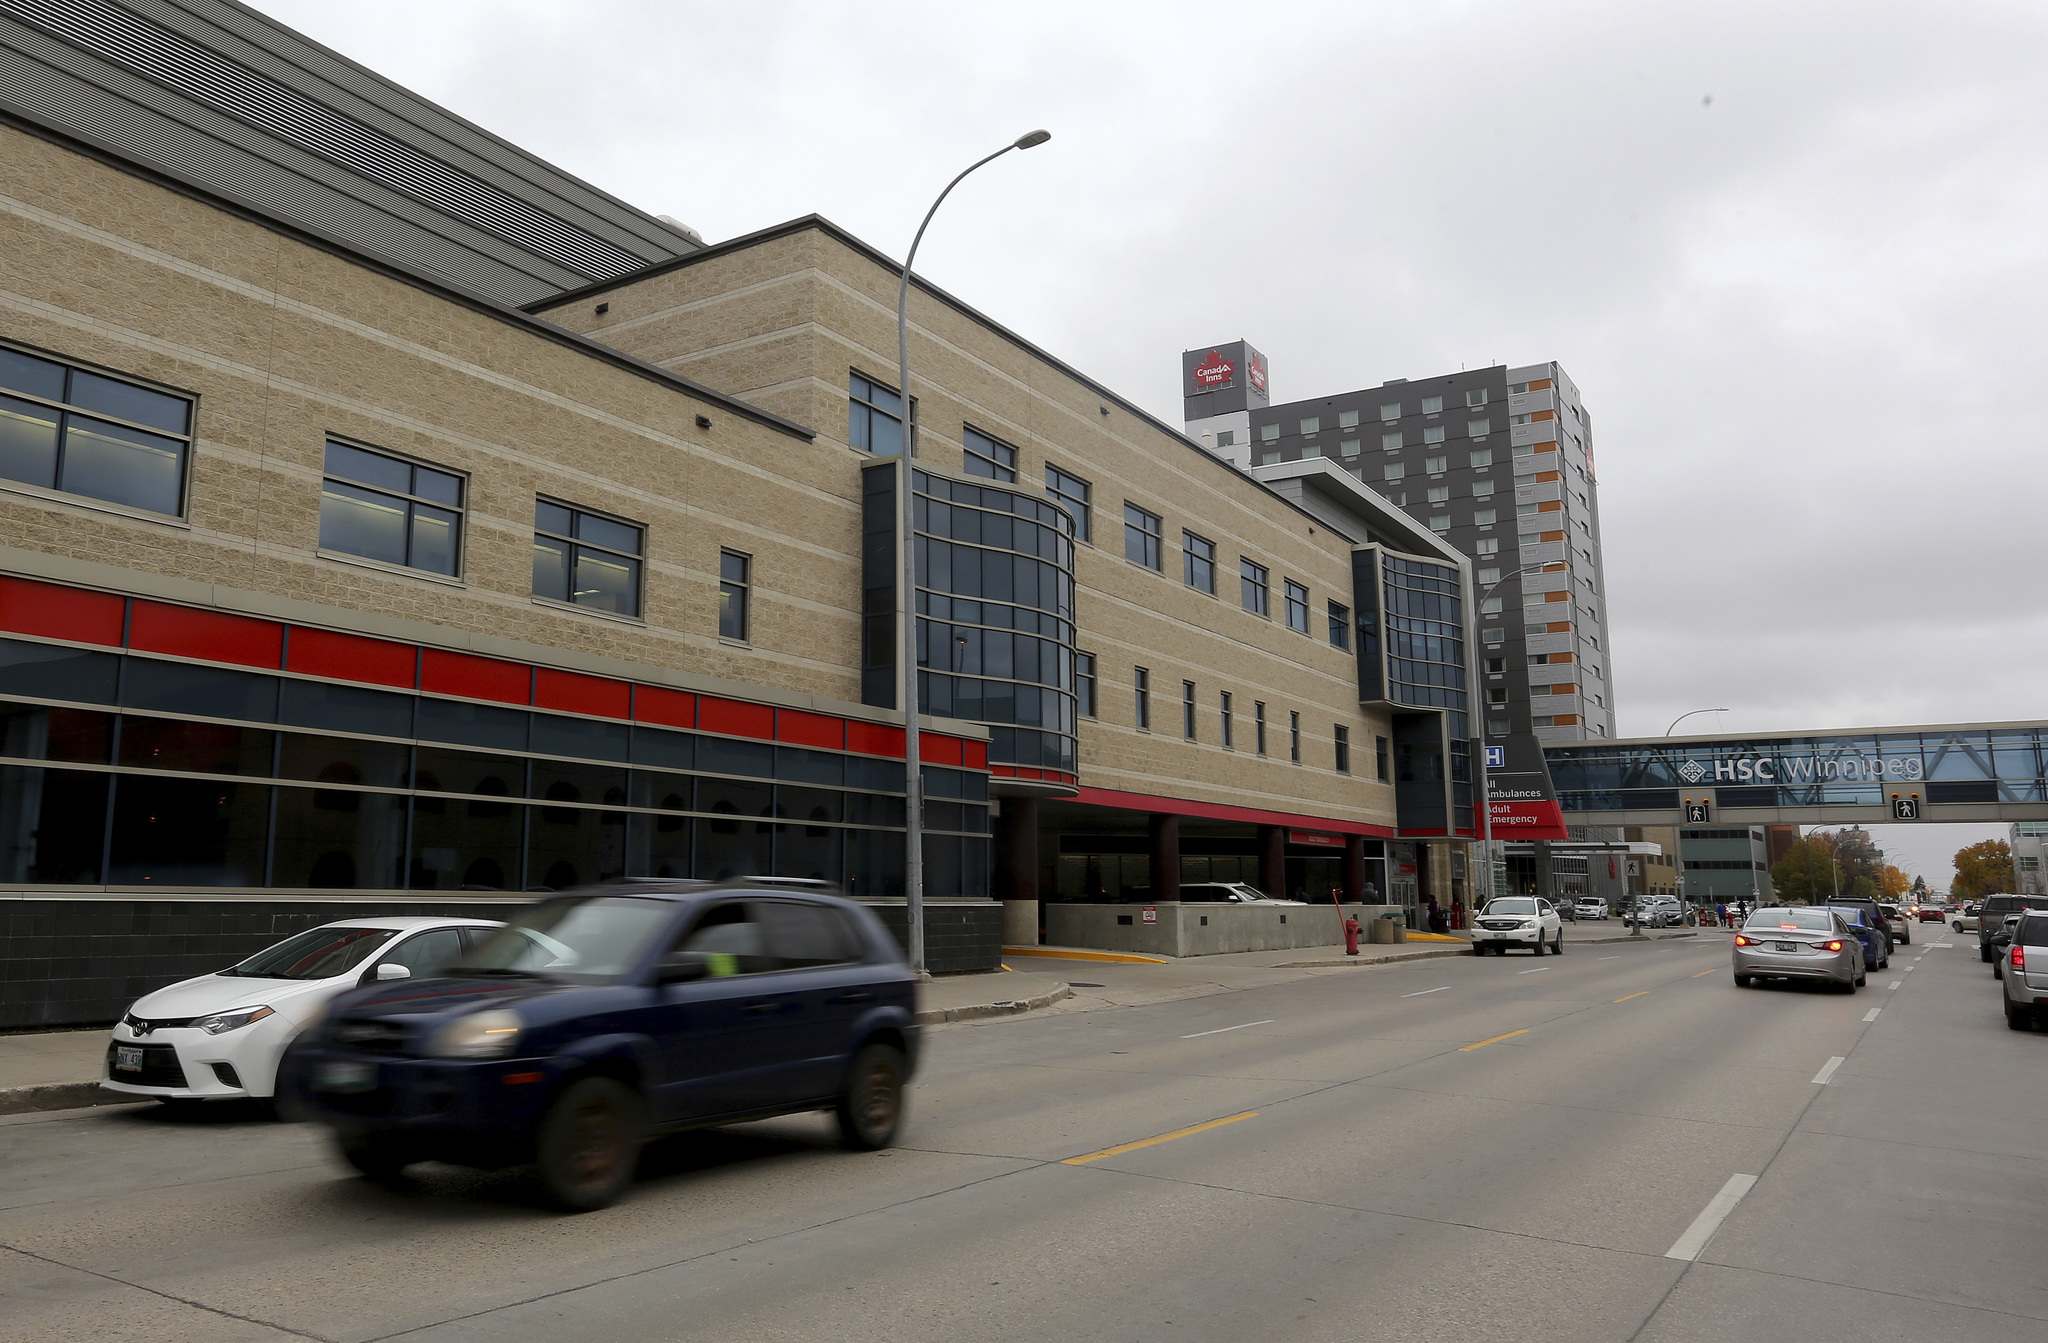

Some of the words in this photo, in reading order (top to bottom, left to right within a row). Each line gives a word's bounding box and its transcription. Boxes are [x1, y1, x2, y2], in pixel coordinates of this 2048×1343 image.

[1205, 374, 1223, 383] Inns
[1485, 748, 1500, 765] H
[1714, 758, 1774, 780] HSC
[1783, 753, 1922, 781] Winnipeg
